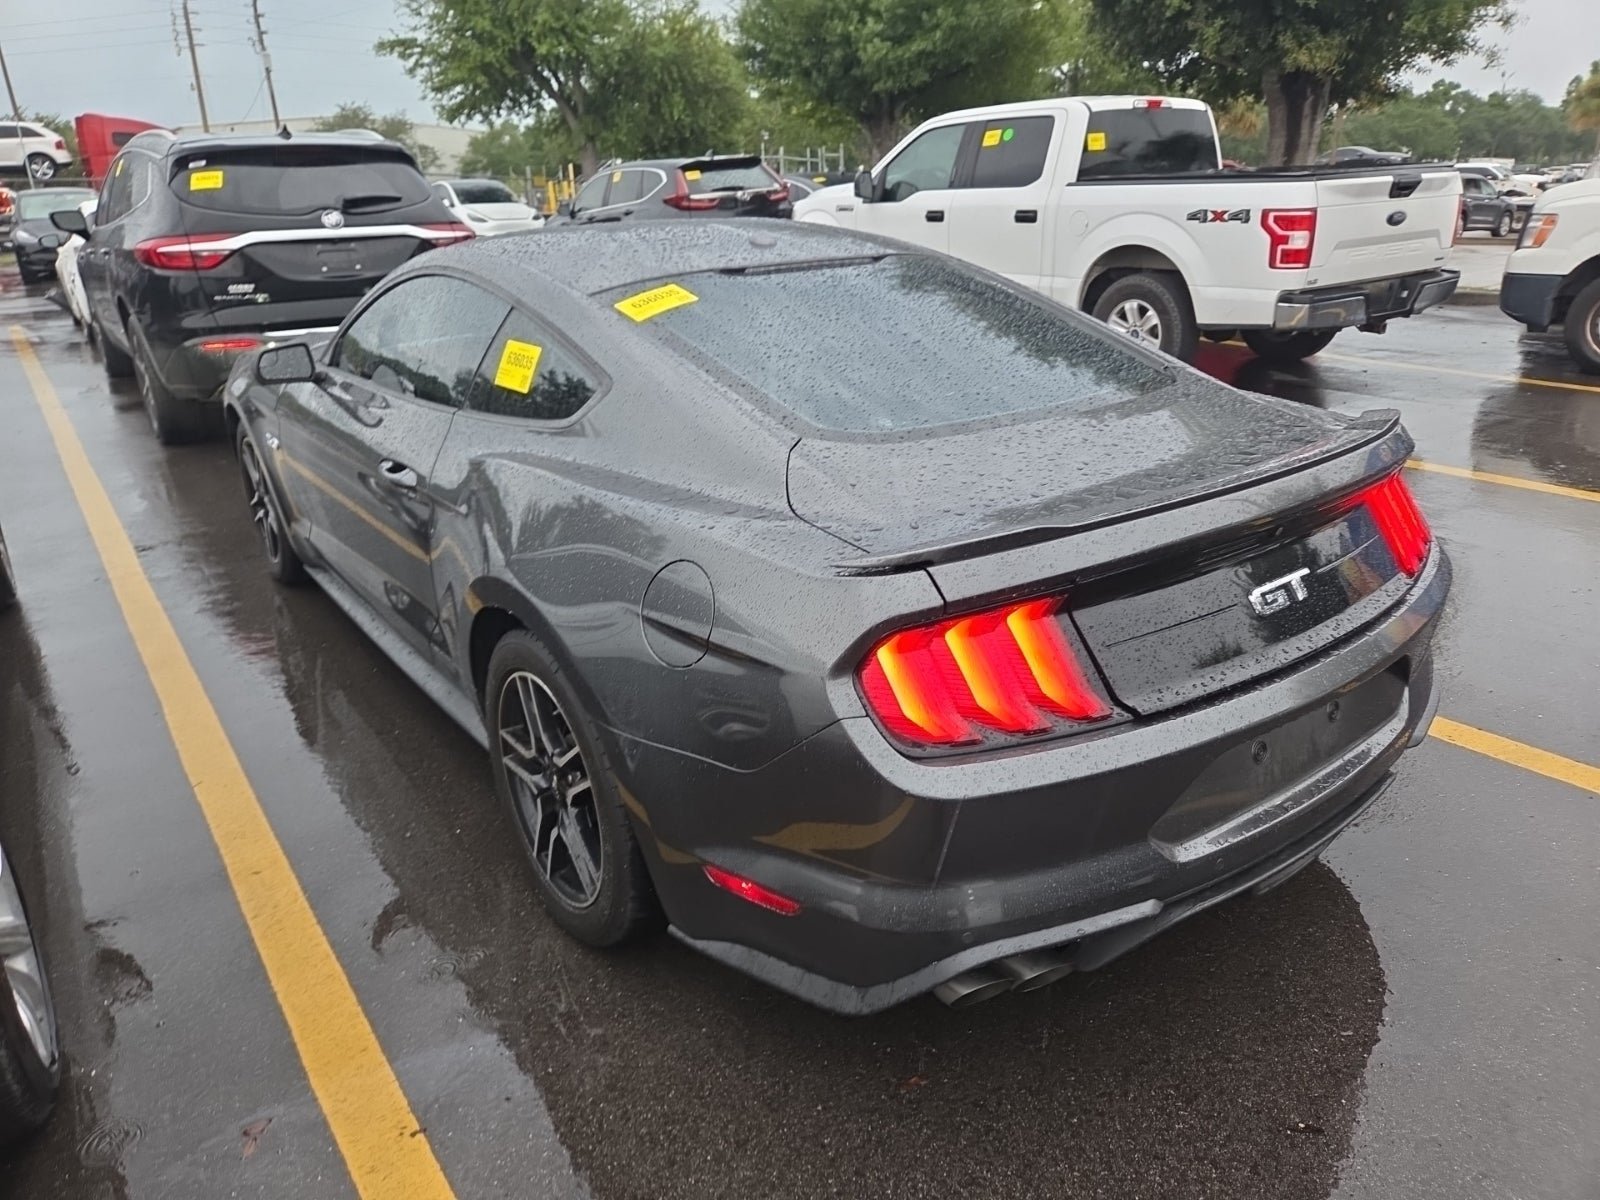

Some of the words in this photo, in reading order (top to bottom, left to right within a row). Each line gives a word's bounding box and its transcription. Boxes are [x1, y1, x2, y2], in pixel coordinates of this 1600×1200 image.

[631, 289, 680, 309] 636035
[506, 351, 534, 371] 636035
[1248, 567, 1311, 615] GT
